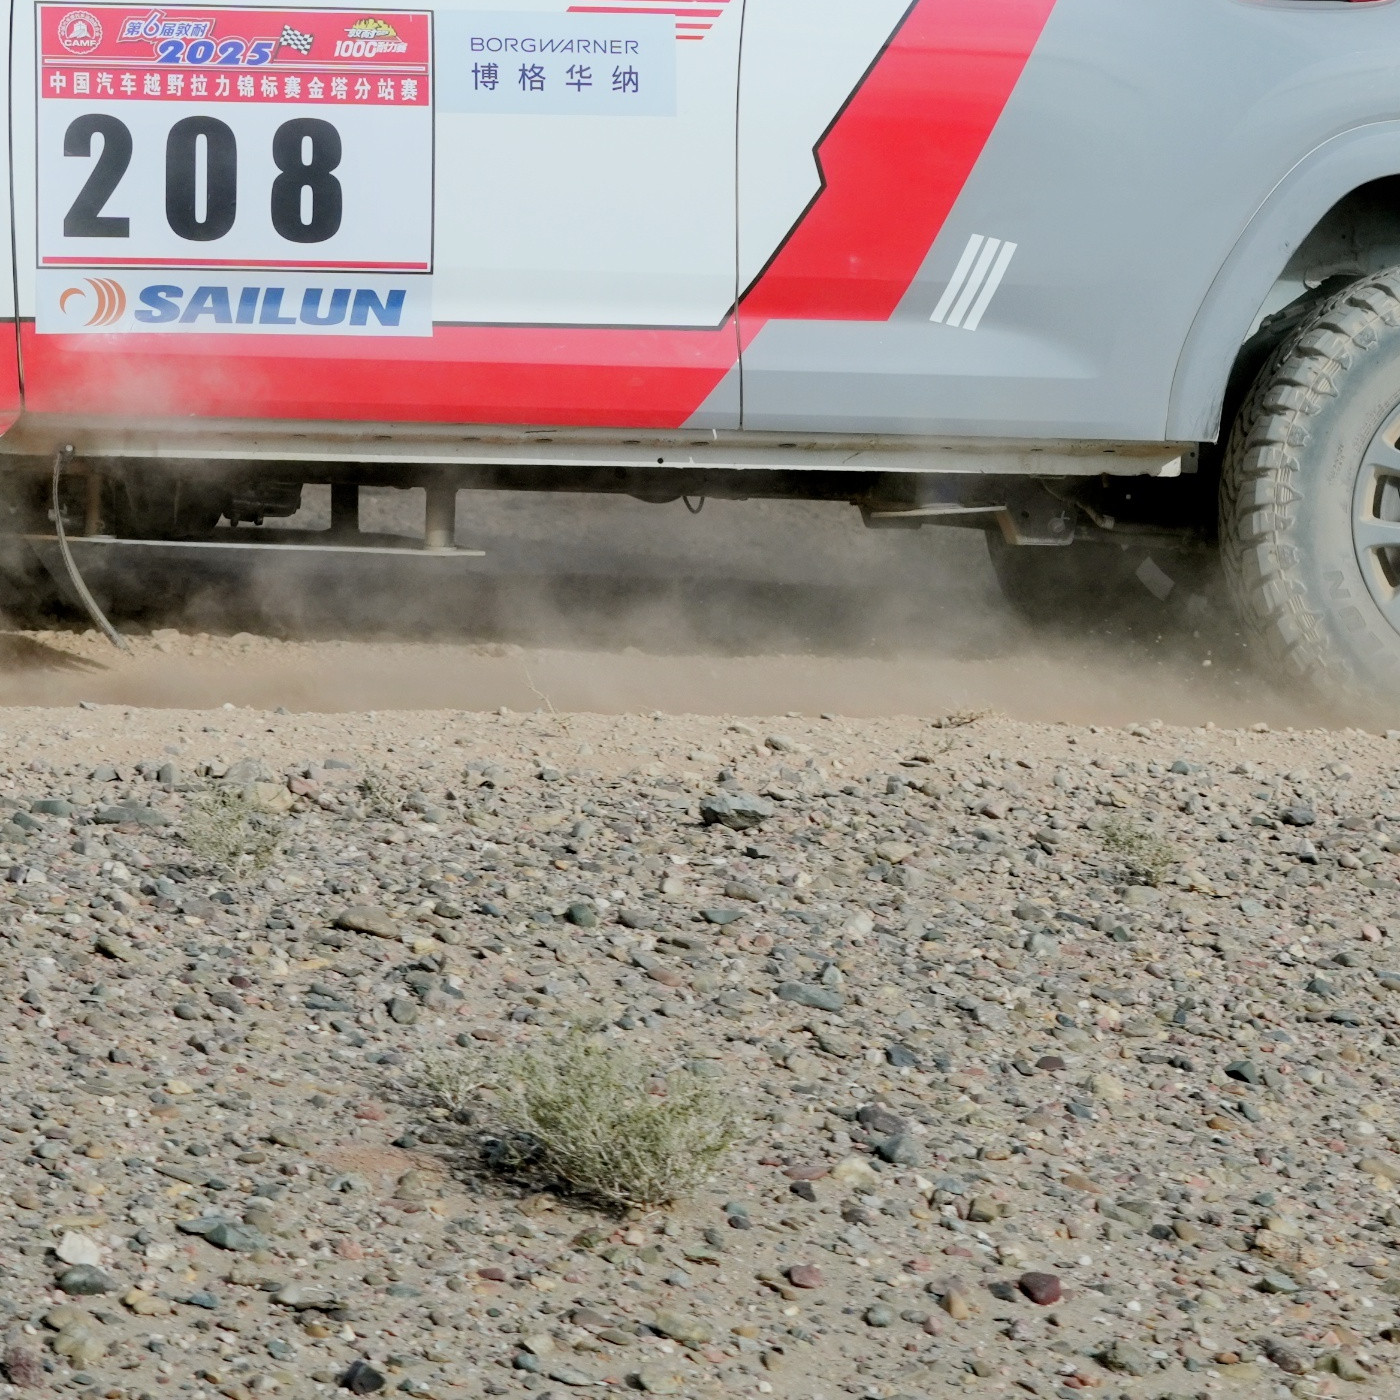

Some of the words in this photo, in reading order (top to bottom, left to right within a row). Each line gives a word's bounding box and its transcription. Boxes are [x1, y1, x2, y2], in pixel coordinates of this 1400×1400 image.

[63, 39, 98, 47] CAMF
[155, 38, 276, 66] 2025
[470, 37, 639, 55] BORGWARNER
[49, 71, 418, 101] 中国汽车越野拉力锦标赛金塔分站赛
[472, 62, 639, 93] 博格华纳
[63, 113, 343, 243] 208
[134, 285, 407, 327] SAILUN
